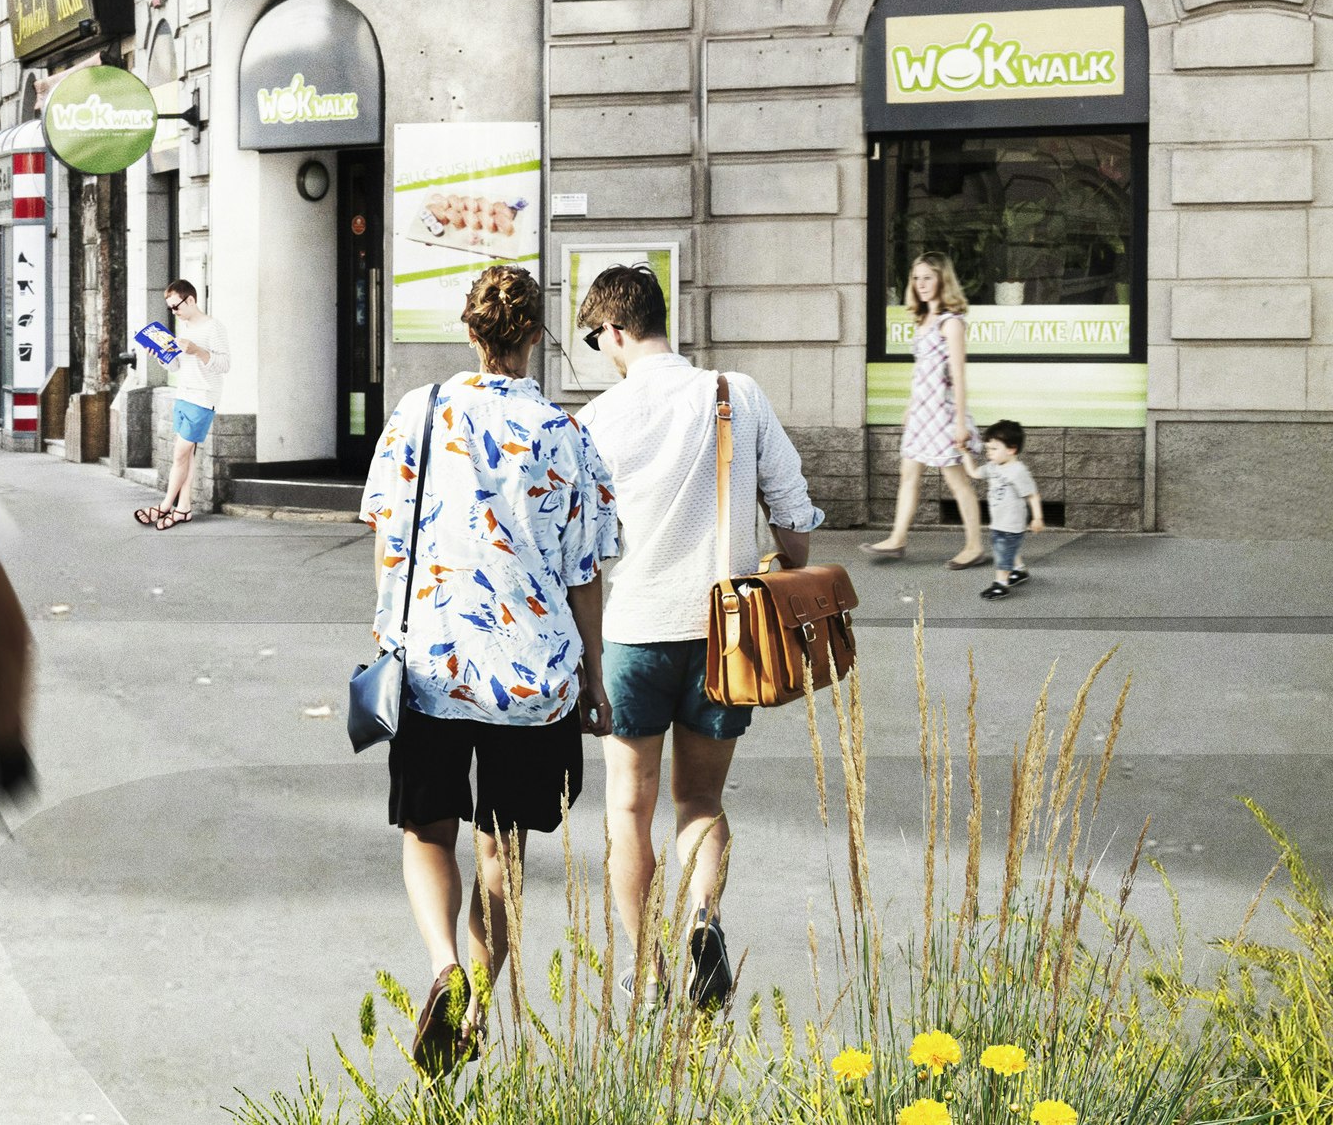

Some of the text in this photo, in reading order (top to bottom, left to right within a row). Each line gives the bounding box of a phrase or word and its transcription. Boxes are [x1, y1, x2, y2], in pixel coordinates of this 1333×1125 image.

[1021, 55, 1112, 84] WALK
[313, 96, 356, 117] WALK
[113, 112, 151, 126] WALK
[436, 159, 479, 178] SUSHI
[890, 322, 1006, 343] REANT
[1020, 321, 1068, 343] TAKE
[1070, 321, 1125, 343] AWAY
